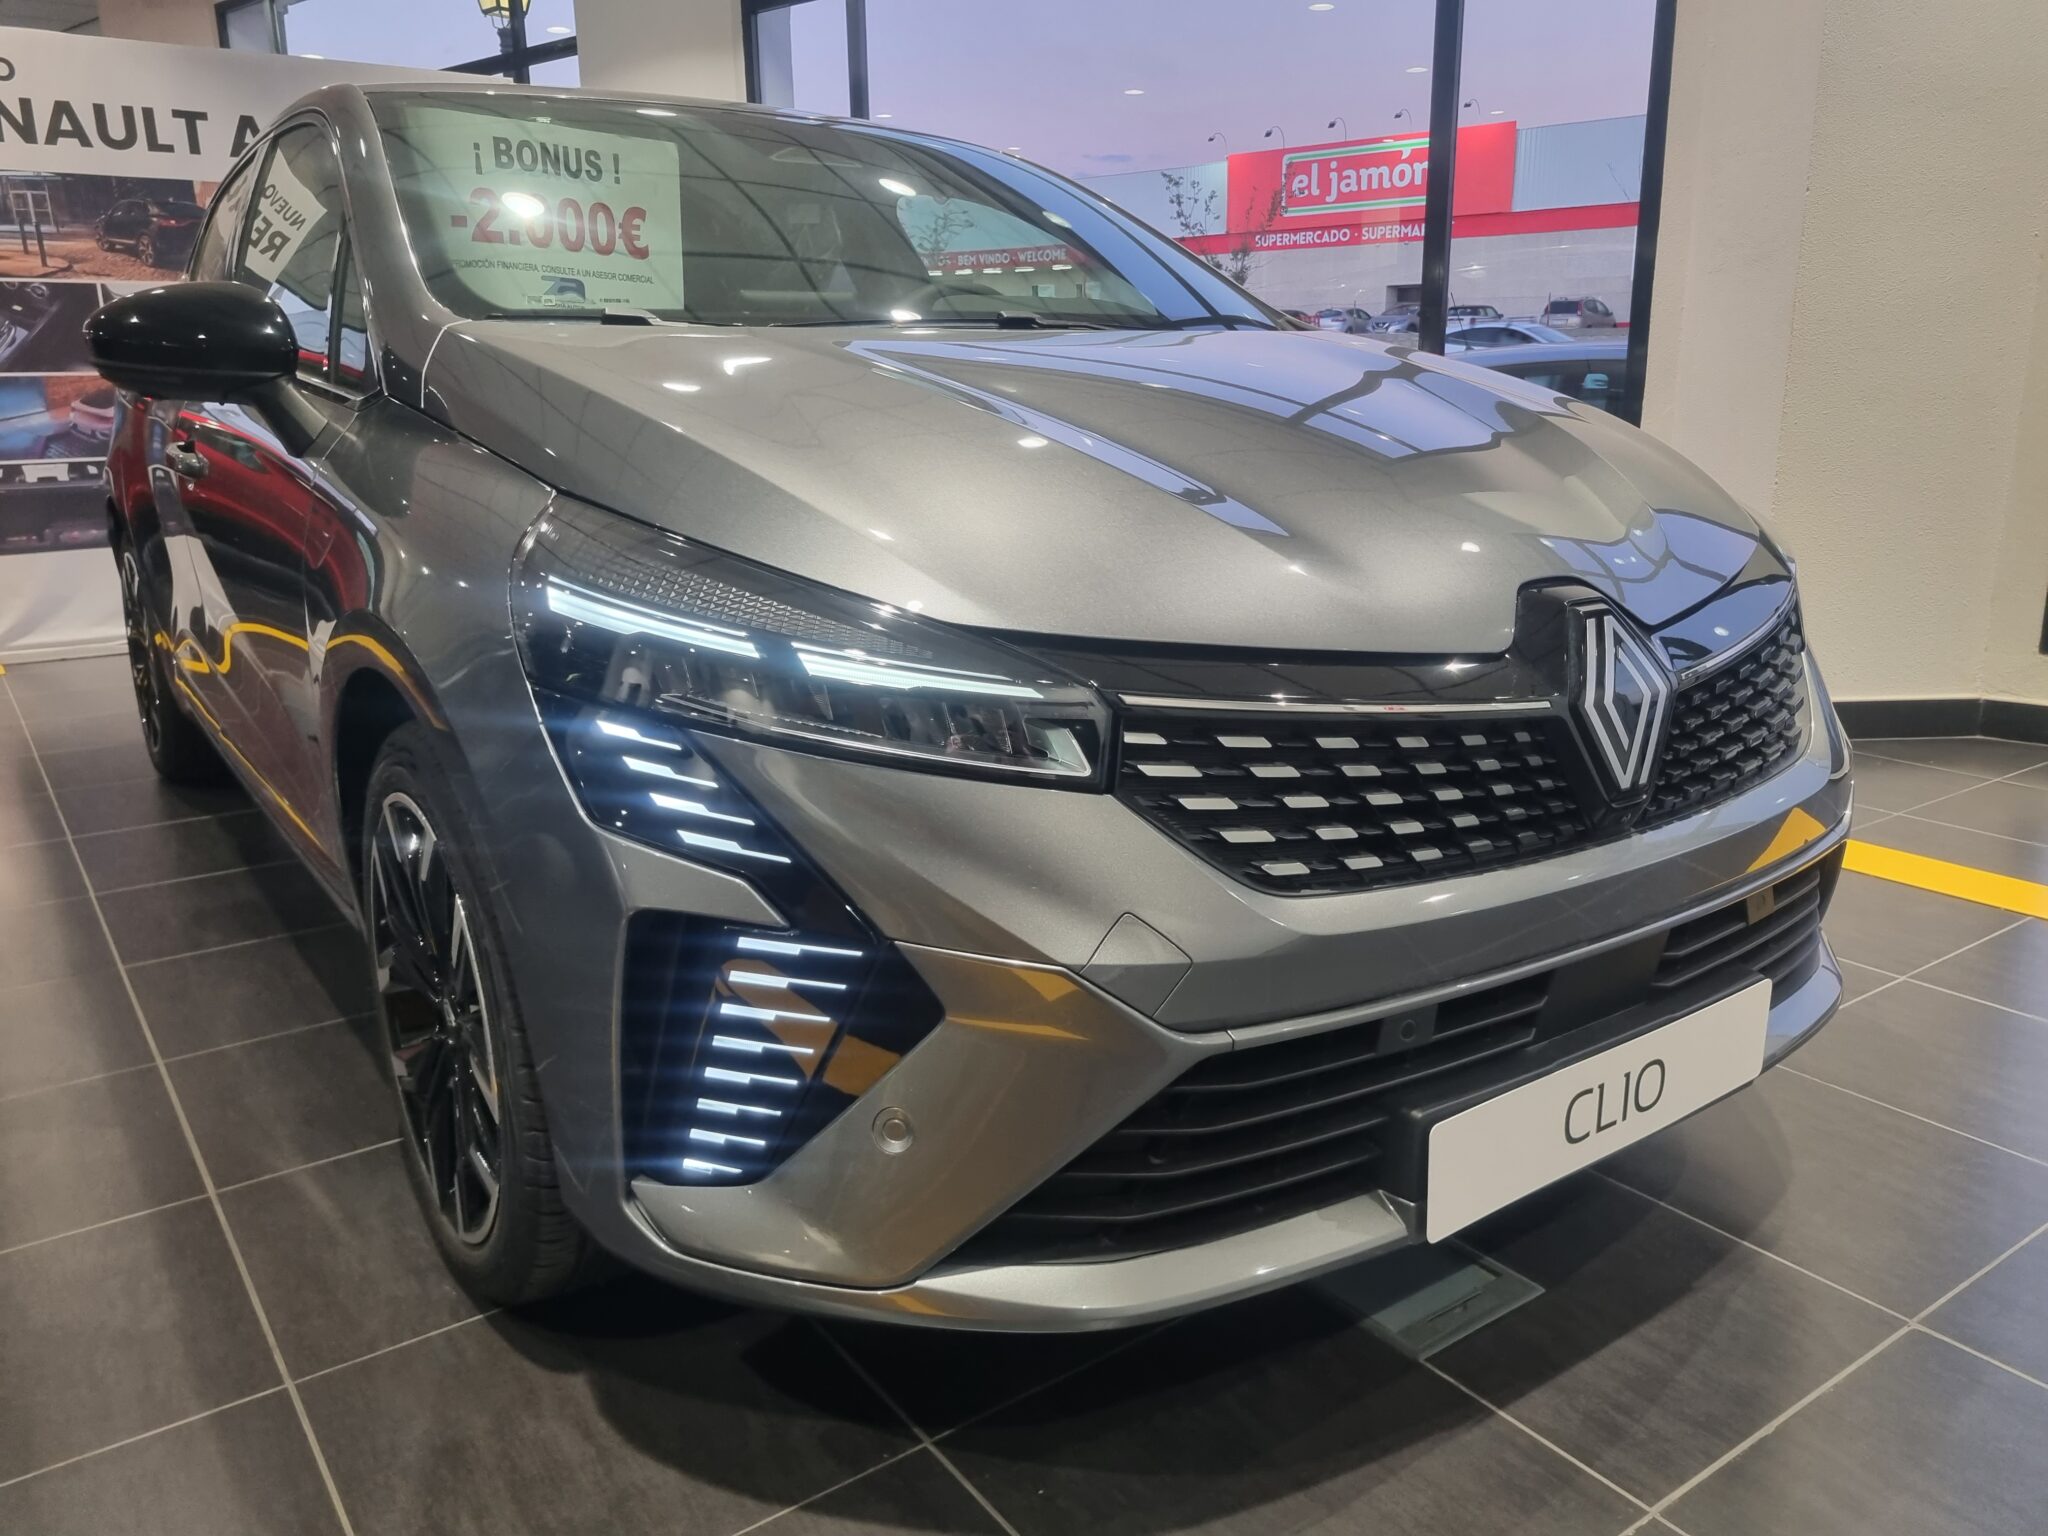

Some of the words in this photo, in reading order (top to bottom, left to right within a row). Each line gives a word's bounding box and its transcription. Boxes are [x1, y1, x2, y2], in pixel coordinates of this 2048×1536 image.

[493, 136, 603, 184] BONUS
[1292, 163, 1320, 197] el
[1255, 228, 1350, 248] SUPERMERCADO
[957, 254, 977, 266] BEM
[979, 252, 1010, 265] VINDO
[1017, 249, 1067, 263] WELCOME
[541, 264, 576, 276] CONSULTE
[592, 270, 617, 281] ASESOR
[618, 273, 654, 284] COMERCIAL
[1564, 1058, 1666, 1145] CLIO
